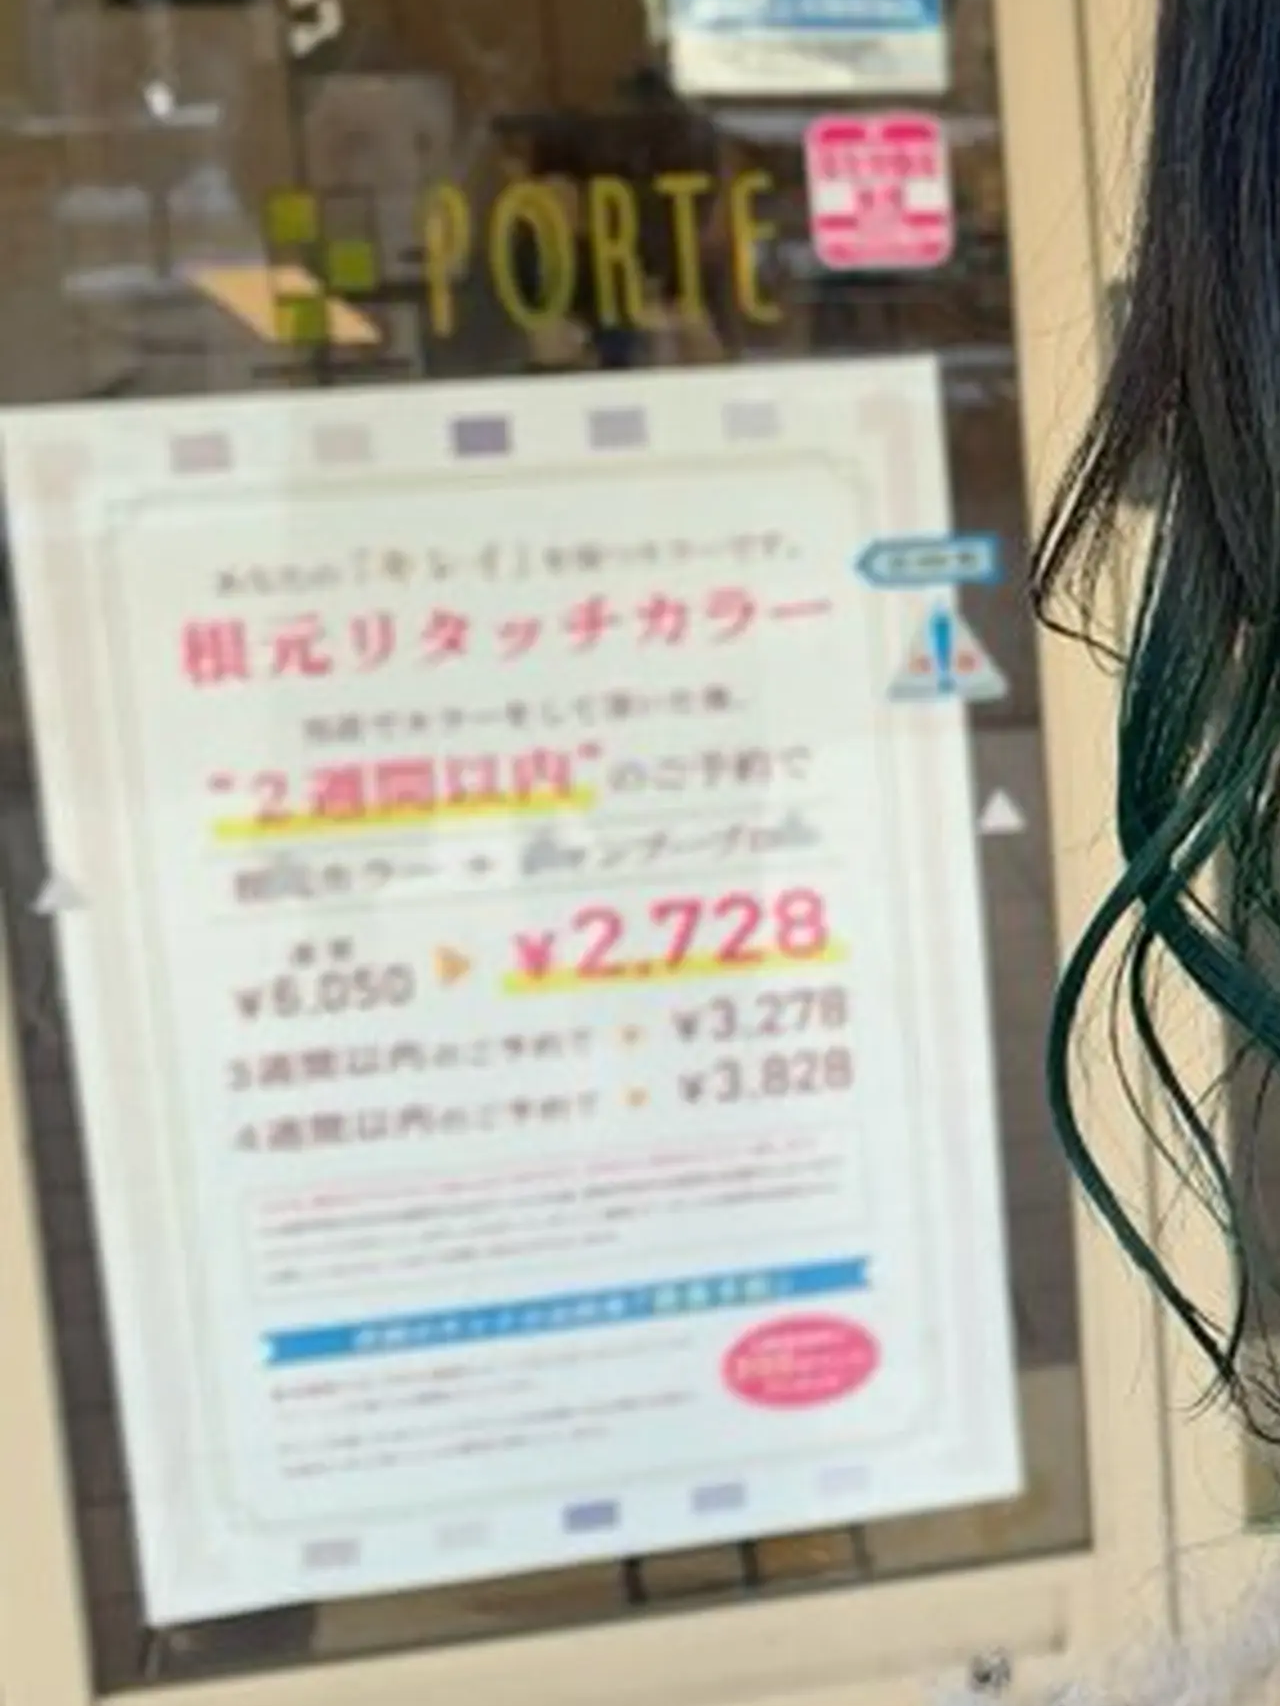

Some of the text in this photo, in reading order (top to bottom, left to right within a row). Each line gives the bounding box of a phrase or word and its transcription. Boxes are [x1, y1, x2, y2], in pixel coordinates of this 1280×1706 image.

[421, 172, 782, 338] PORTE
[180, 587, 832, 683] 根元リタッチカラー
